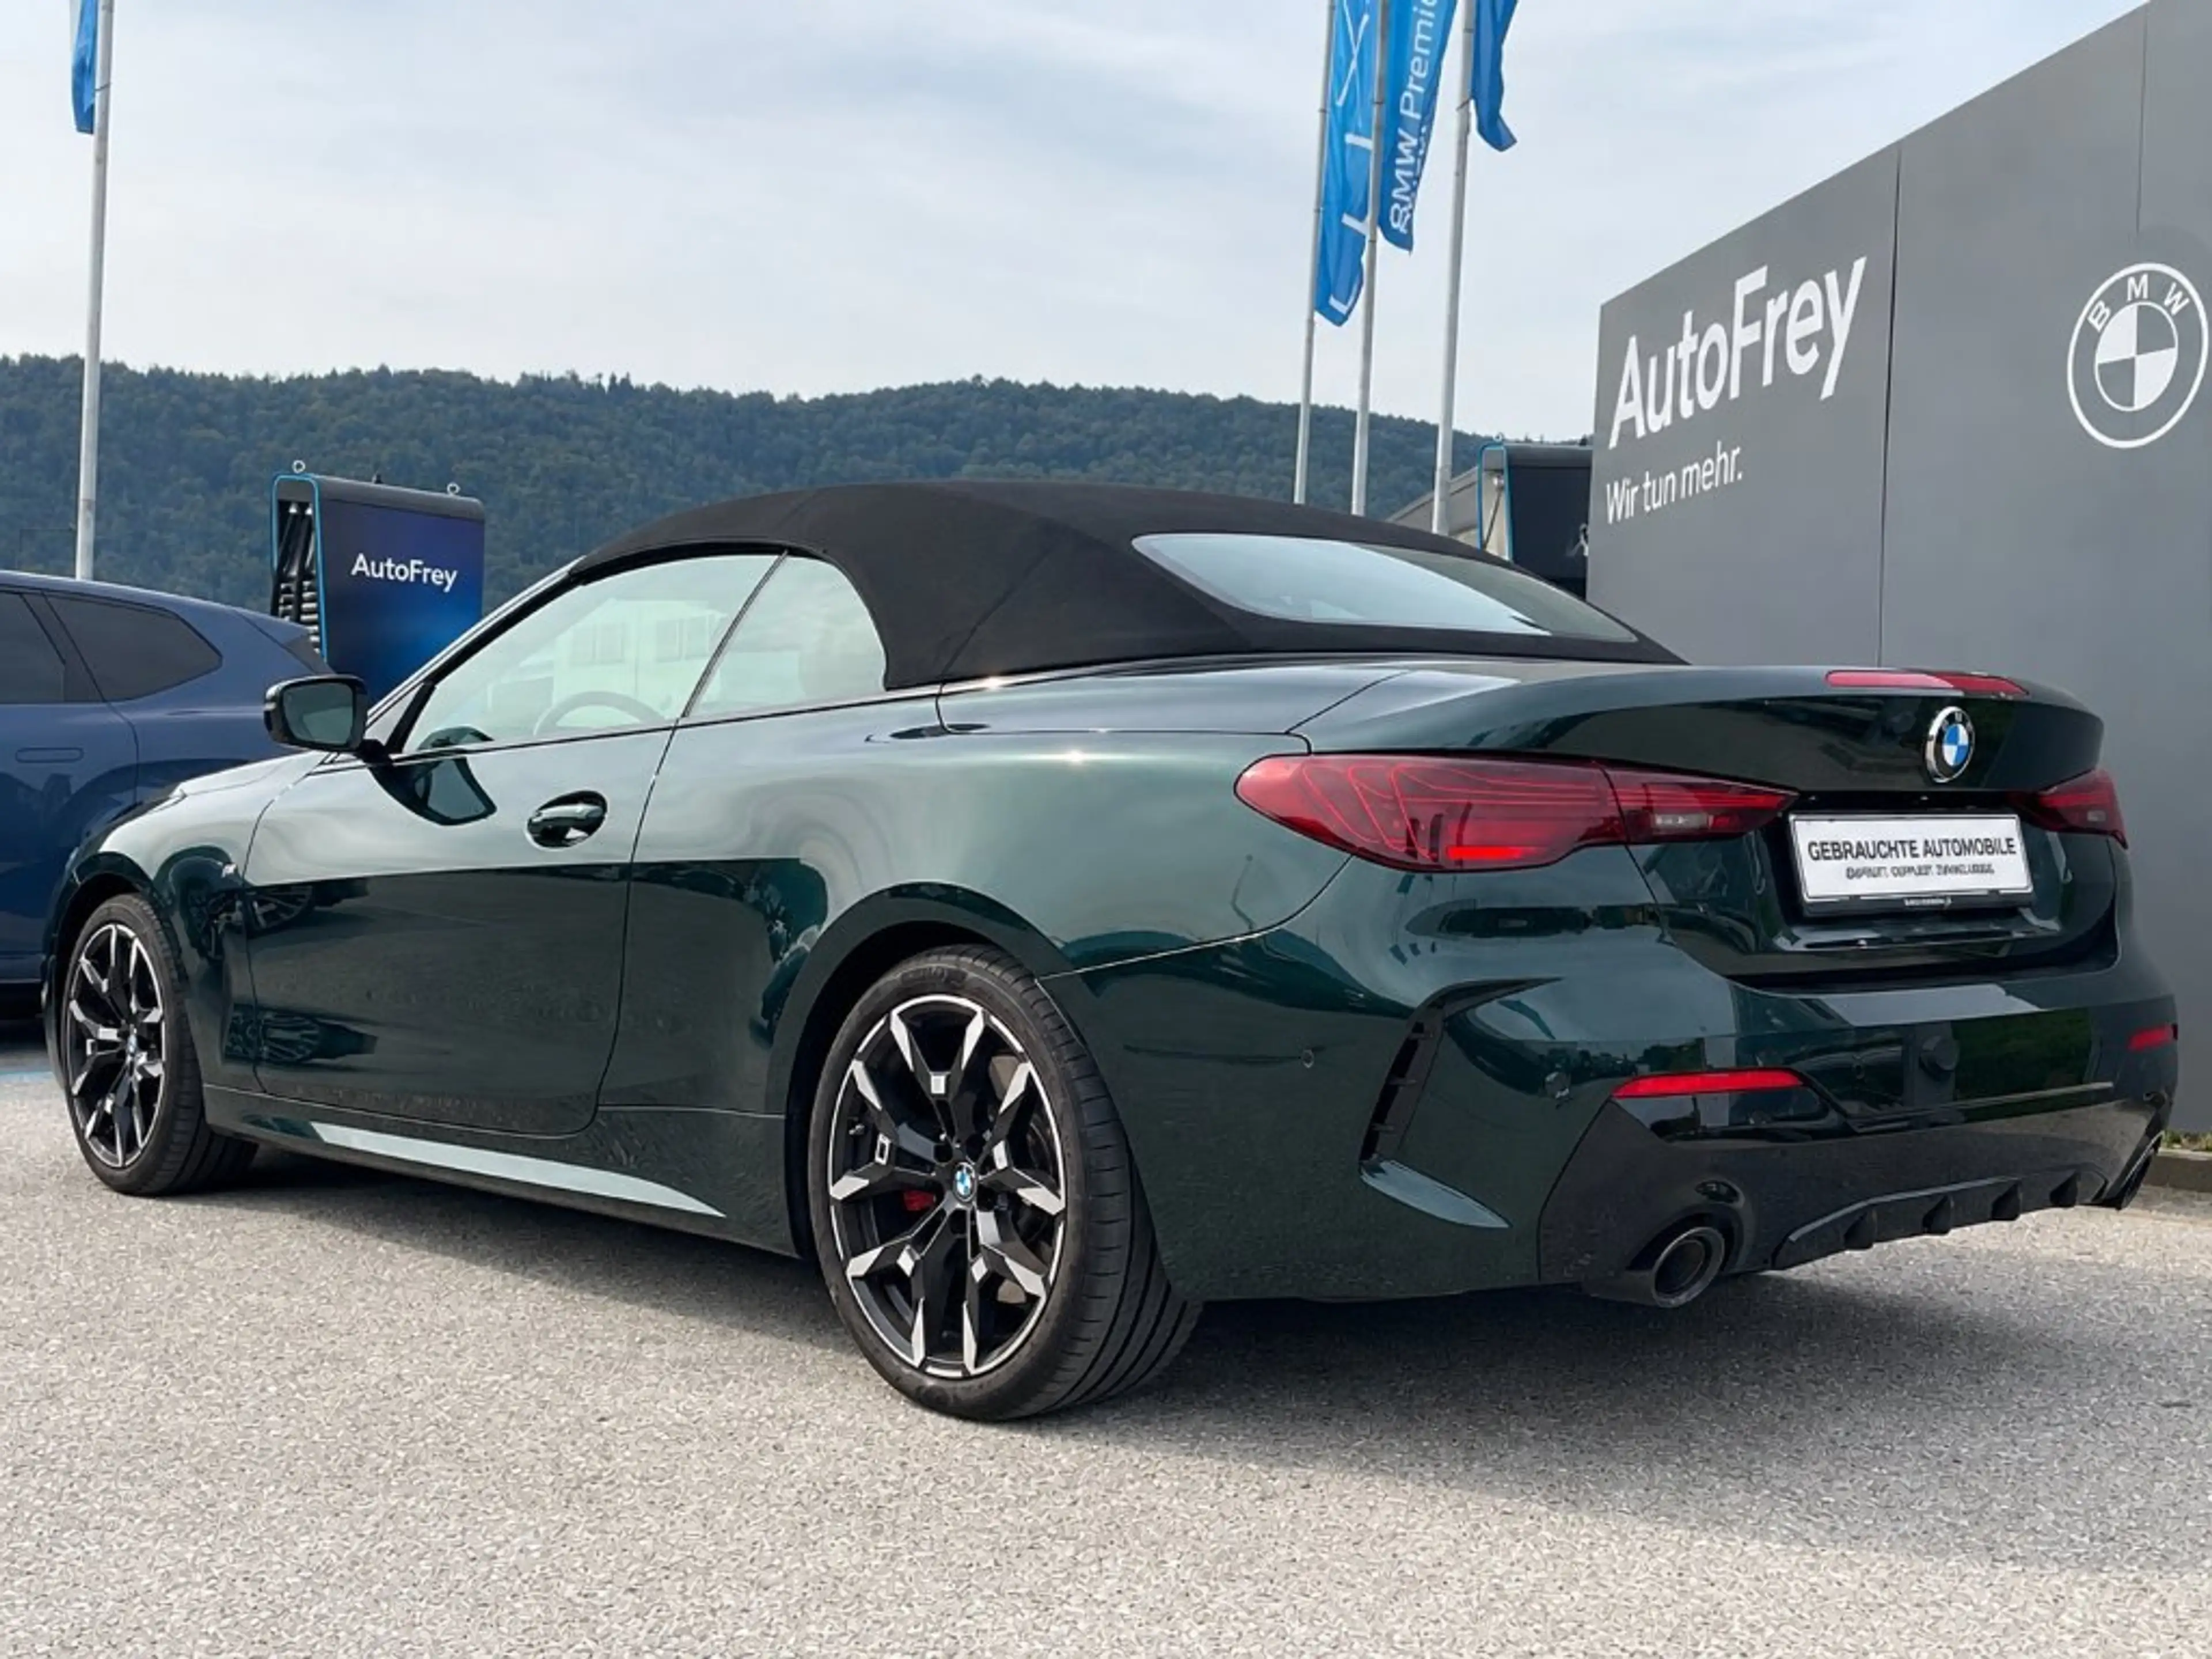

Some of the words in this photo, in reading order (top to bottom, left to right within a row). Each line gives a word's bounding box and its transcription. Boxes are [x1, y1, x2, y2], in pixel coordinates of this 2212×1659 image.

[1399, 0, 1438, 120] Premi
[2086, 273, 2190, 333] BMW
[1608, 256, 1867, 450] AutoFrey
[1605, 477, 1640, 524] Wir
[1642, 471, 1677, 513] tun
[1680, 440, 1743, 499] mehr.
[350, 552, 458, 593] AutoFrey
[1808, 840, 1919, 861] GEBRAUCHTE
[1923, 837, 2016, 857] AUTOMOBILE
